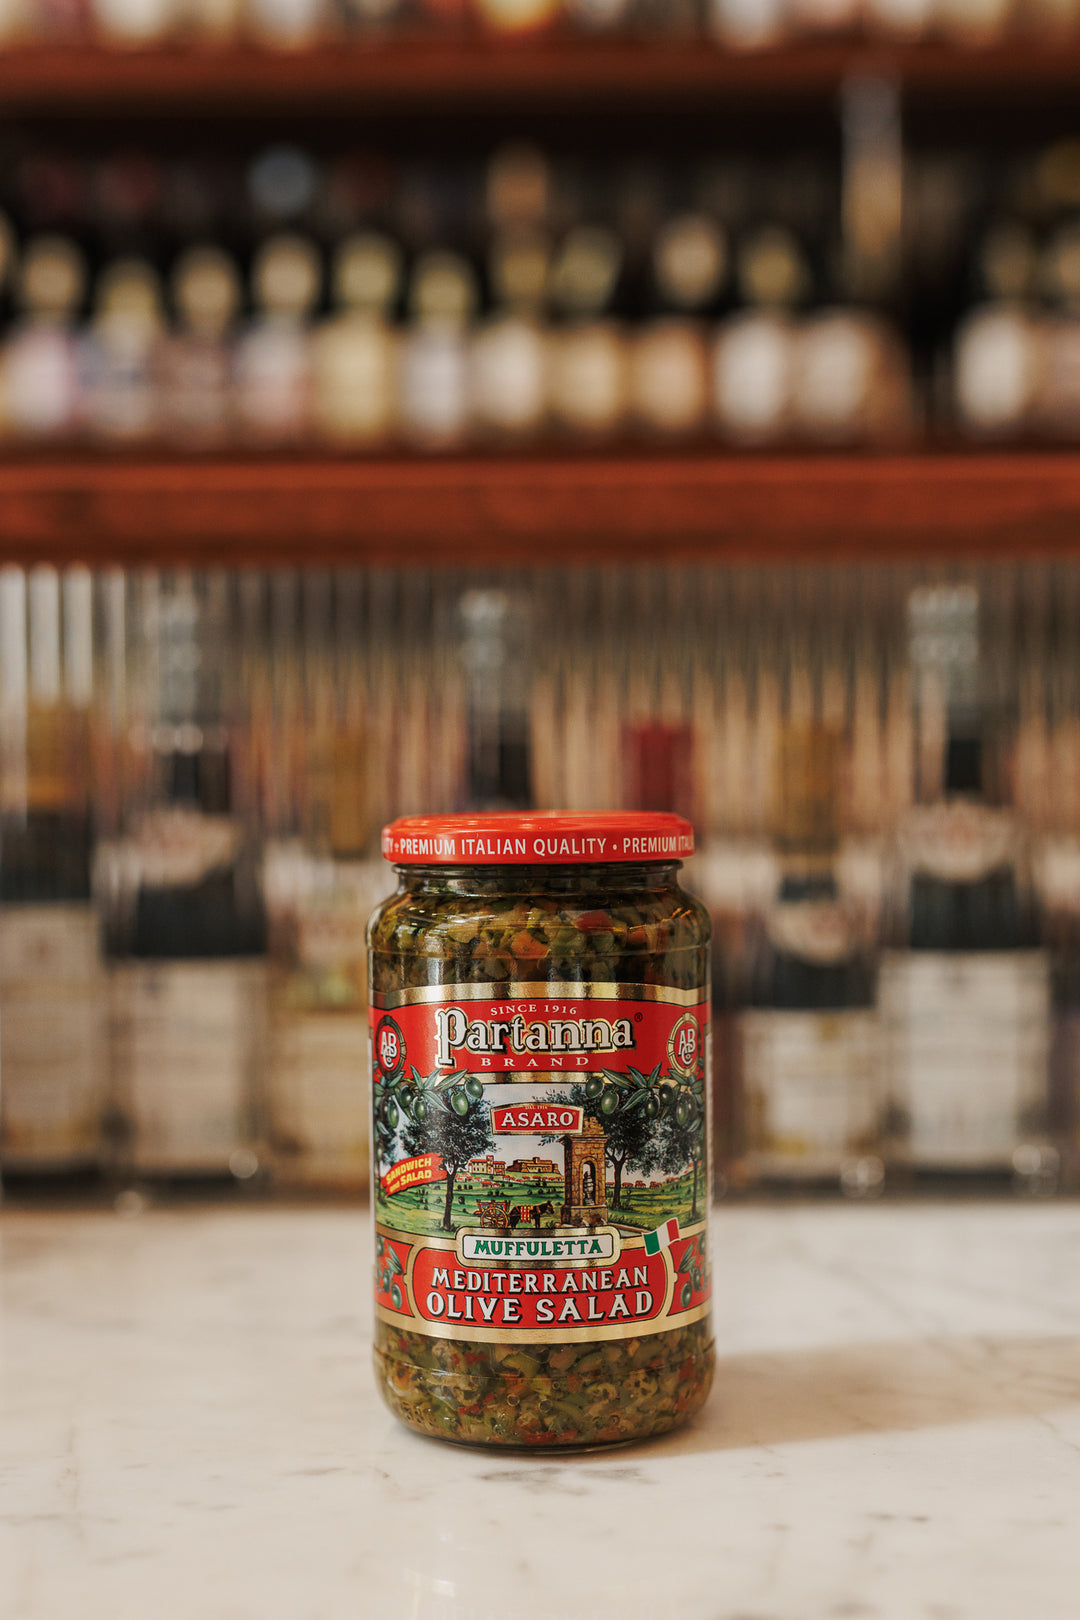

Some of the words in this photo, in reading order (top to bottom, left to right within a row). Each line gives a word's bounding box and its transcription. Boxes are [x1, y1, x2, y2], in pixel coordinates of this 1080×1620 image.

[400, 838, 456, 855] PREMIUM
[461, 838, 526, 855] ITALIAN
[533, 837, 607, 857] QUALITY
[623, 836, 677, 853] PREMIUM
[490, 1004, 536, 1016] SINCE
[544, 1004, 577, 1015] 1916
[436, 1007, 634, 1066] Partanna
[481, 1057, 589, 1067] BRAND
[501, 1112, 574, 1128] ASARO
[386, 1157, 431, 1185] SANDWICH
[400, 1169, 432, 1186] SALAD
[474, 1240, 603, 1256] MUFFULETTA
[431, 1266, 649, 1294] MEDITERRANEAN
[427, 1293, 523, 1323] OLIVE
[536, 1291, 653, 1323] SALAD
